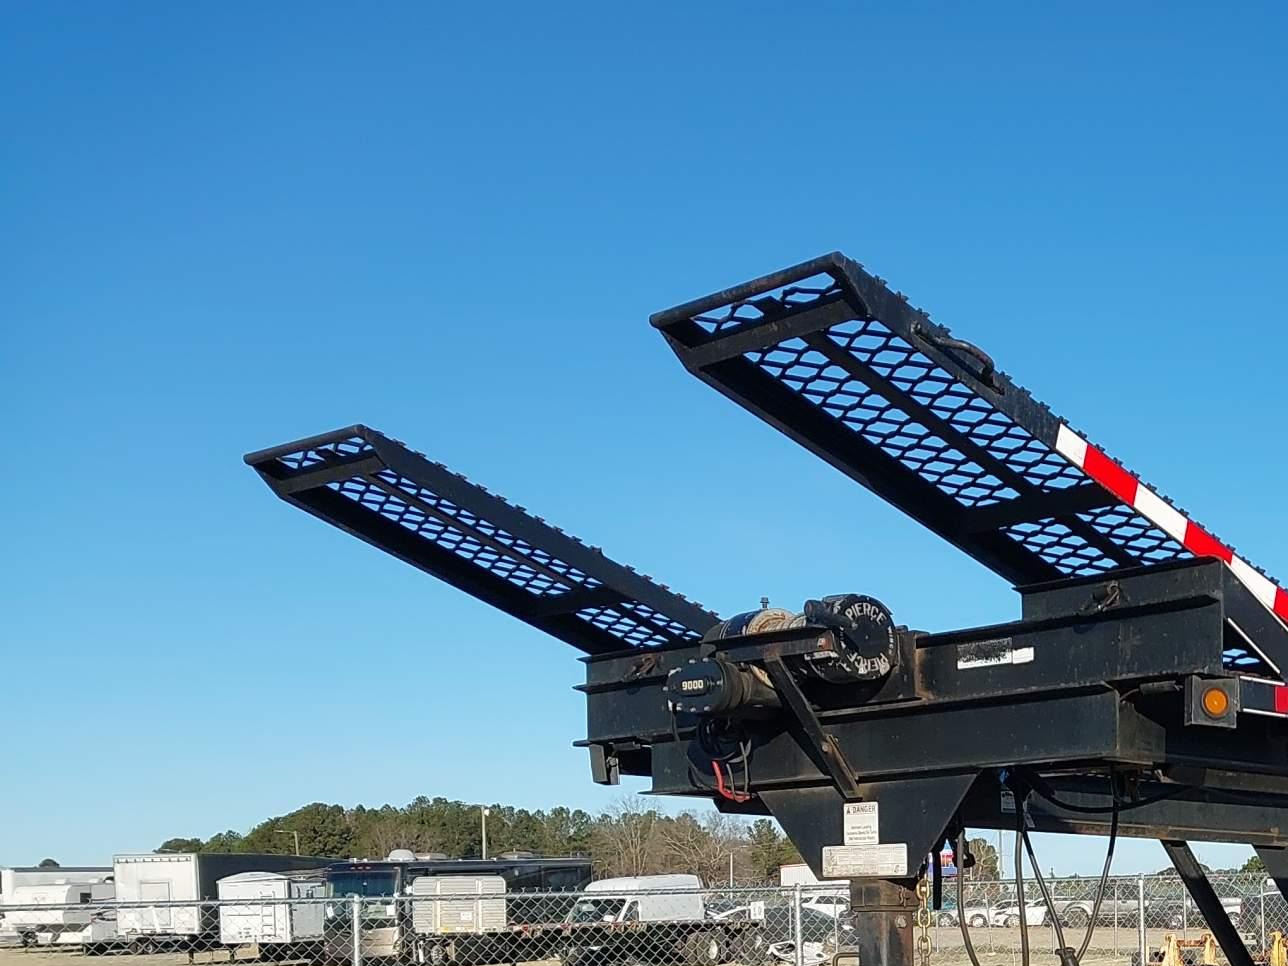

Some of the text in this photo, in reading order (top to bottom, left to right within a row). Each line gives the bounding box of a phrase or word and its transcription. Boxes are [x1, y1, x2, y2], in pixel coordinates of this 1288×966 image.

[845, 602, 887, 625] PIERCE
[681, 679, 704, 690] 9000
[852, 804, 876, 814] DANGER
